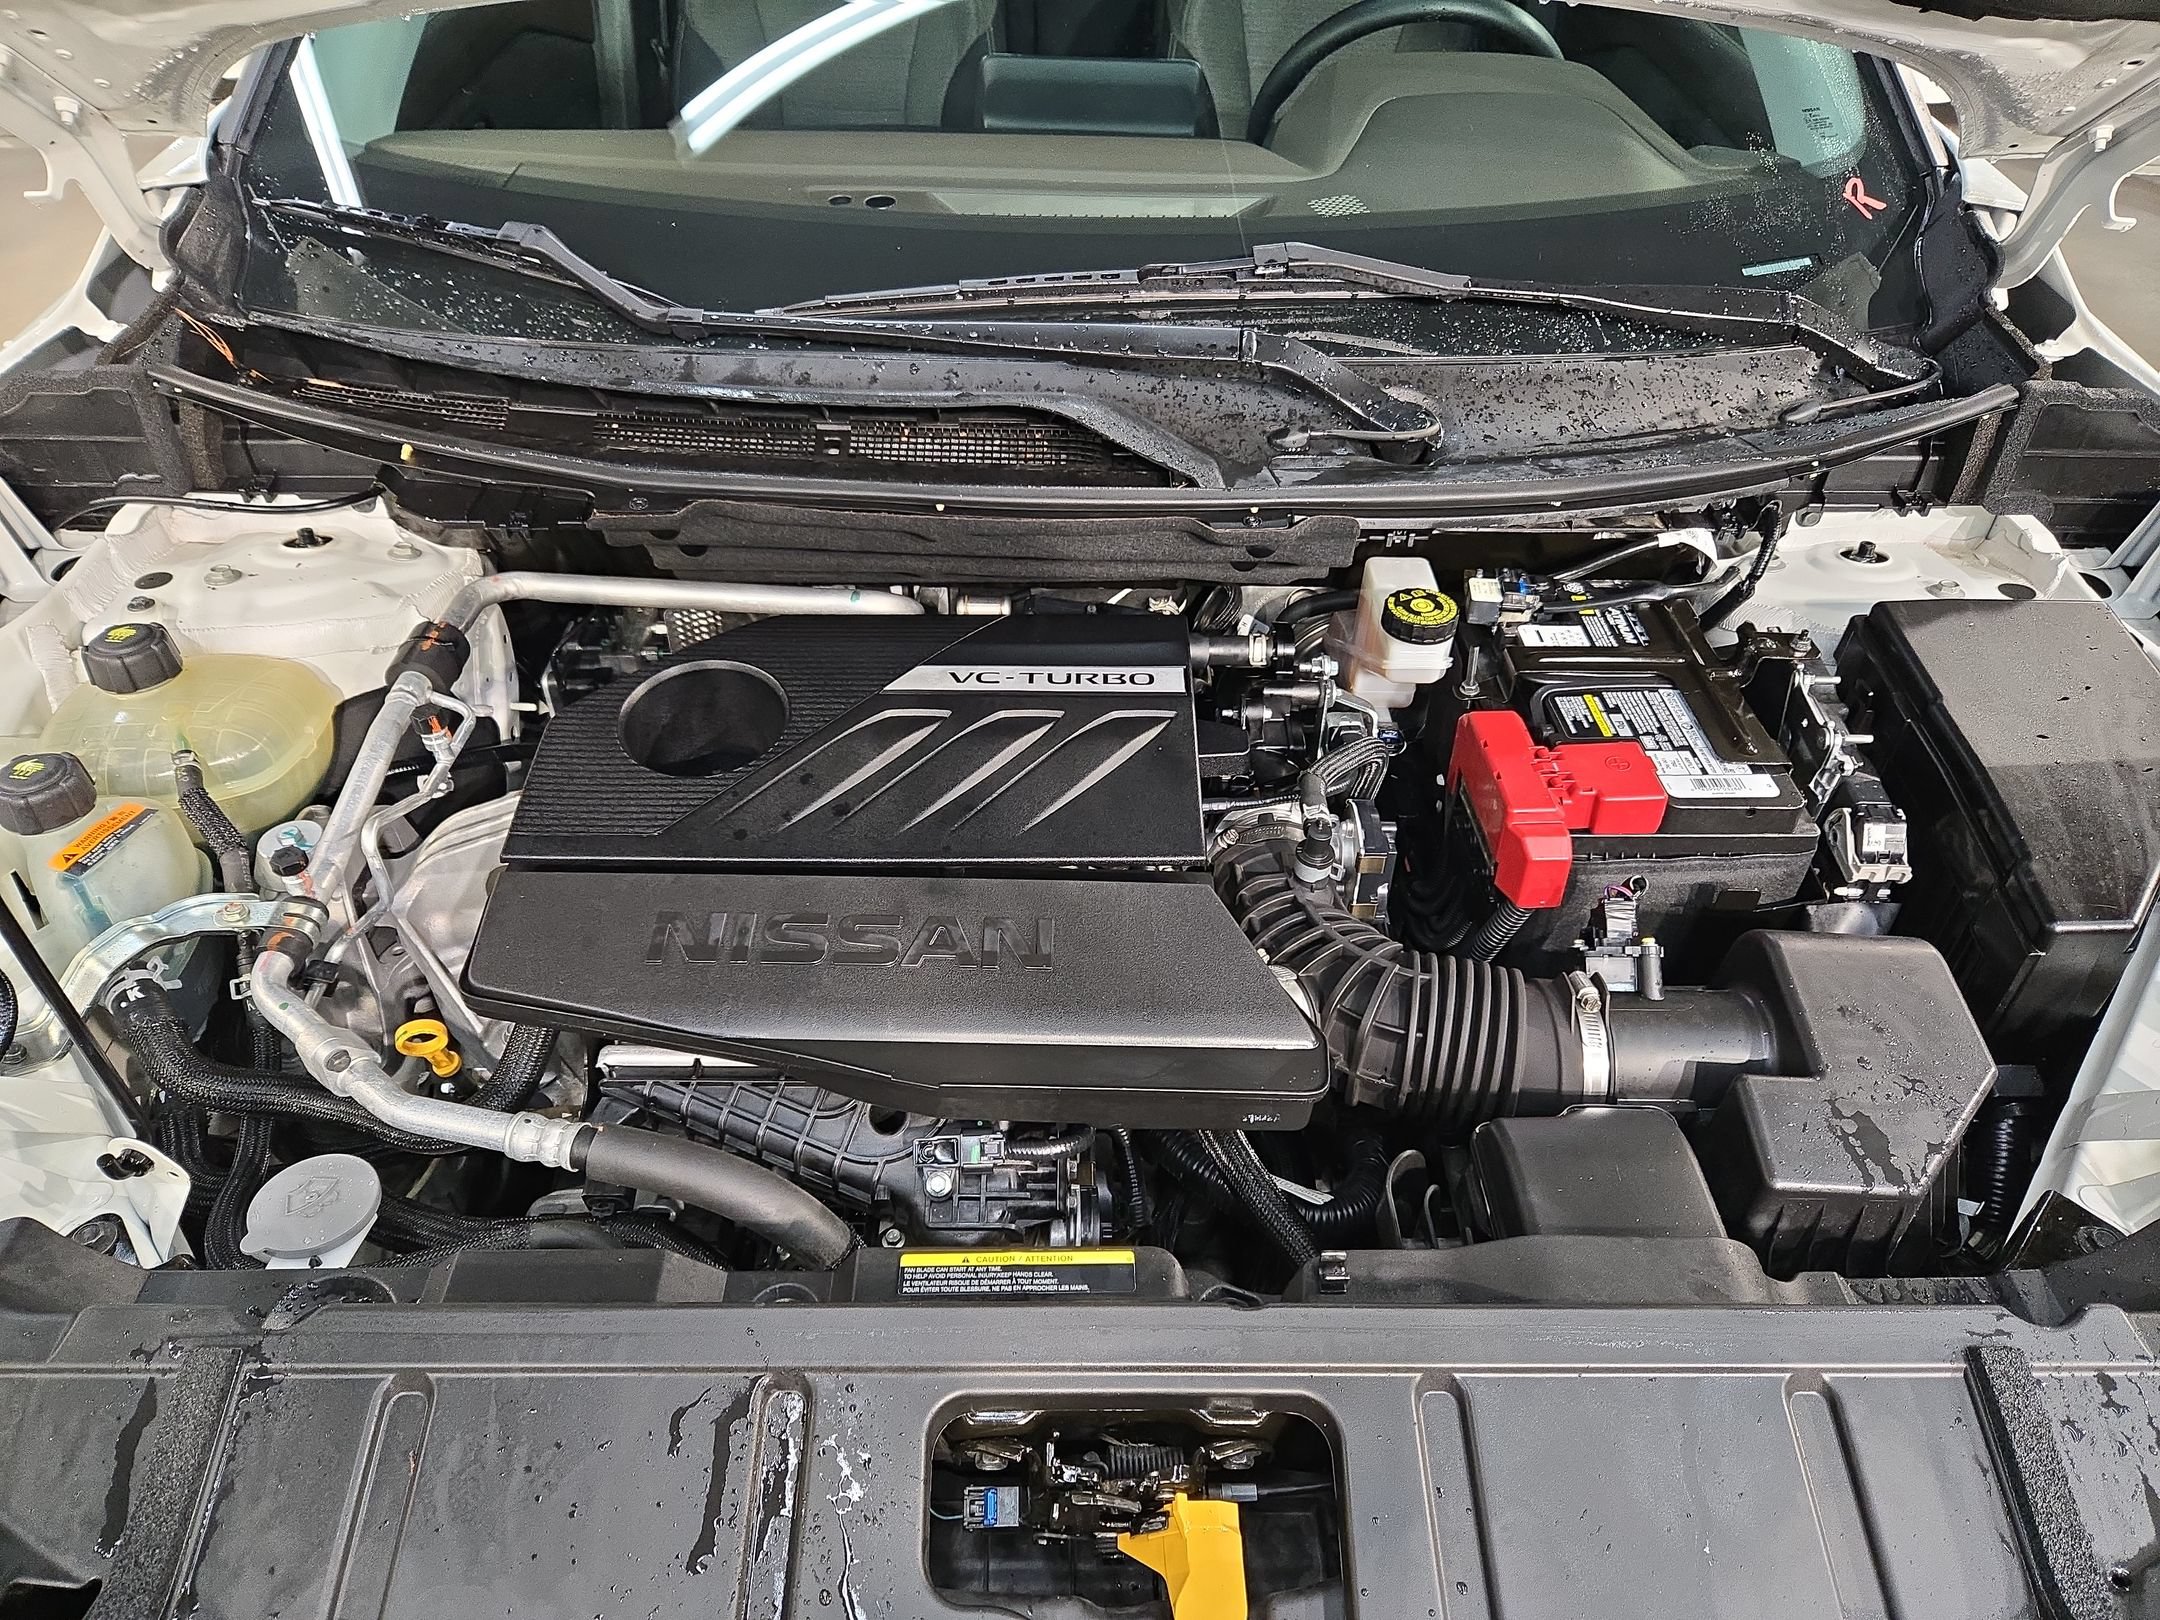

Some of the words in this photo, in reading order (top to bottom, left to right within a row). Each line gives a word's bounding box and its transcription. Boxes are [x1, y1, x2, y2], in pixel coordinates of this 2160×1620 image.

[1843, 177, 1887, 220] R
[949, 672, 1155, 685] VC-TURBO
[74, 823, 106, 848] WARNING
[81, 810, 136, 851] AVERTISSEMENT
[645, 911, 1053, 972] NISSAN
[126, 985, 146, 1002] K
[976, 1255, 1015, 1263] CAUTION
[1025, 1255, 1073, 1263] ATTENTION
[980, 1278, 1011, 1286] DÉMARRER
[1012, 1284, 1021, 1292] EN
[1022, 1284, 1058, 1292] APPROCHER
